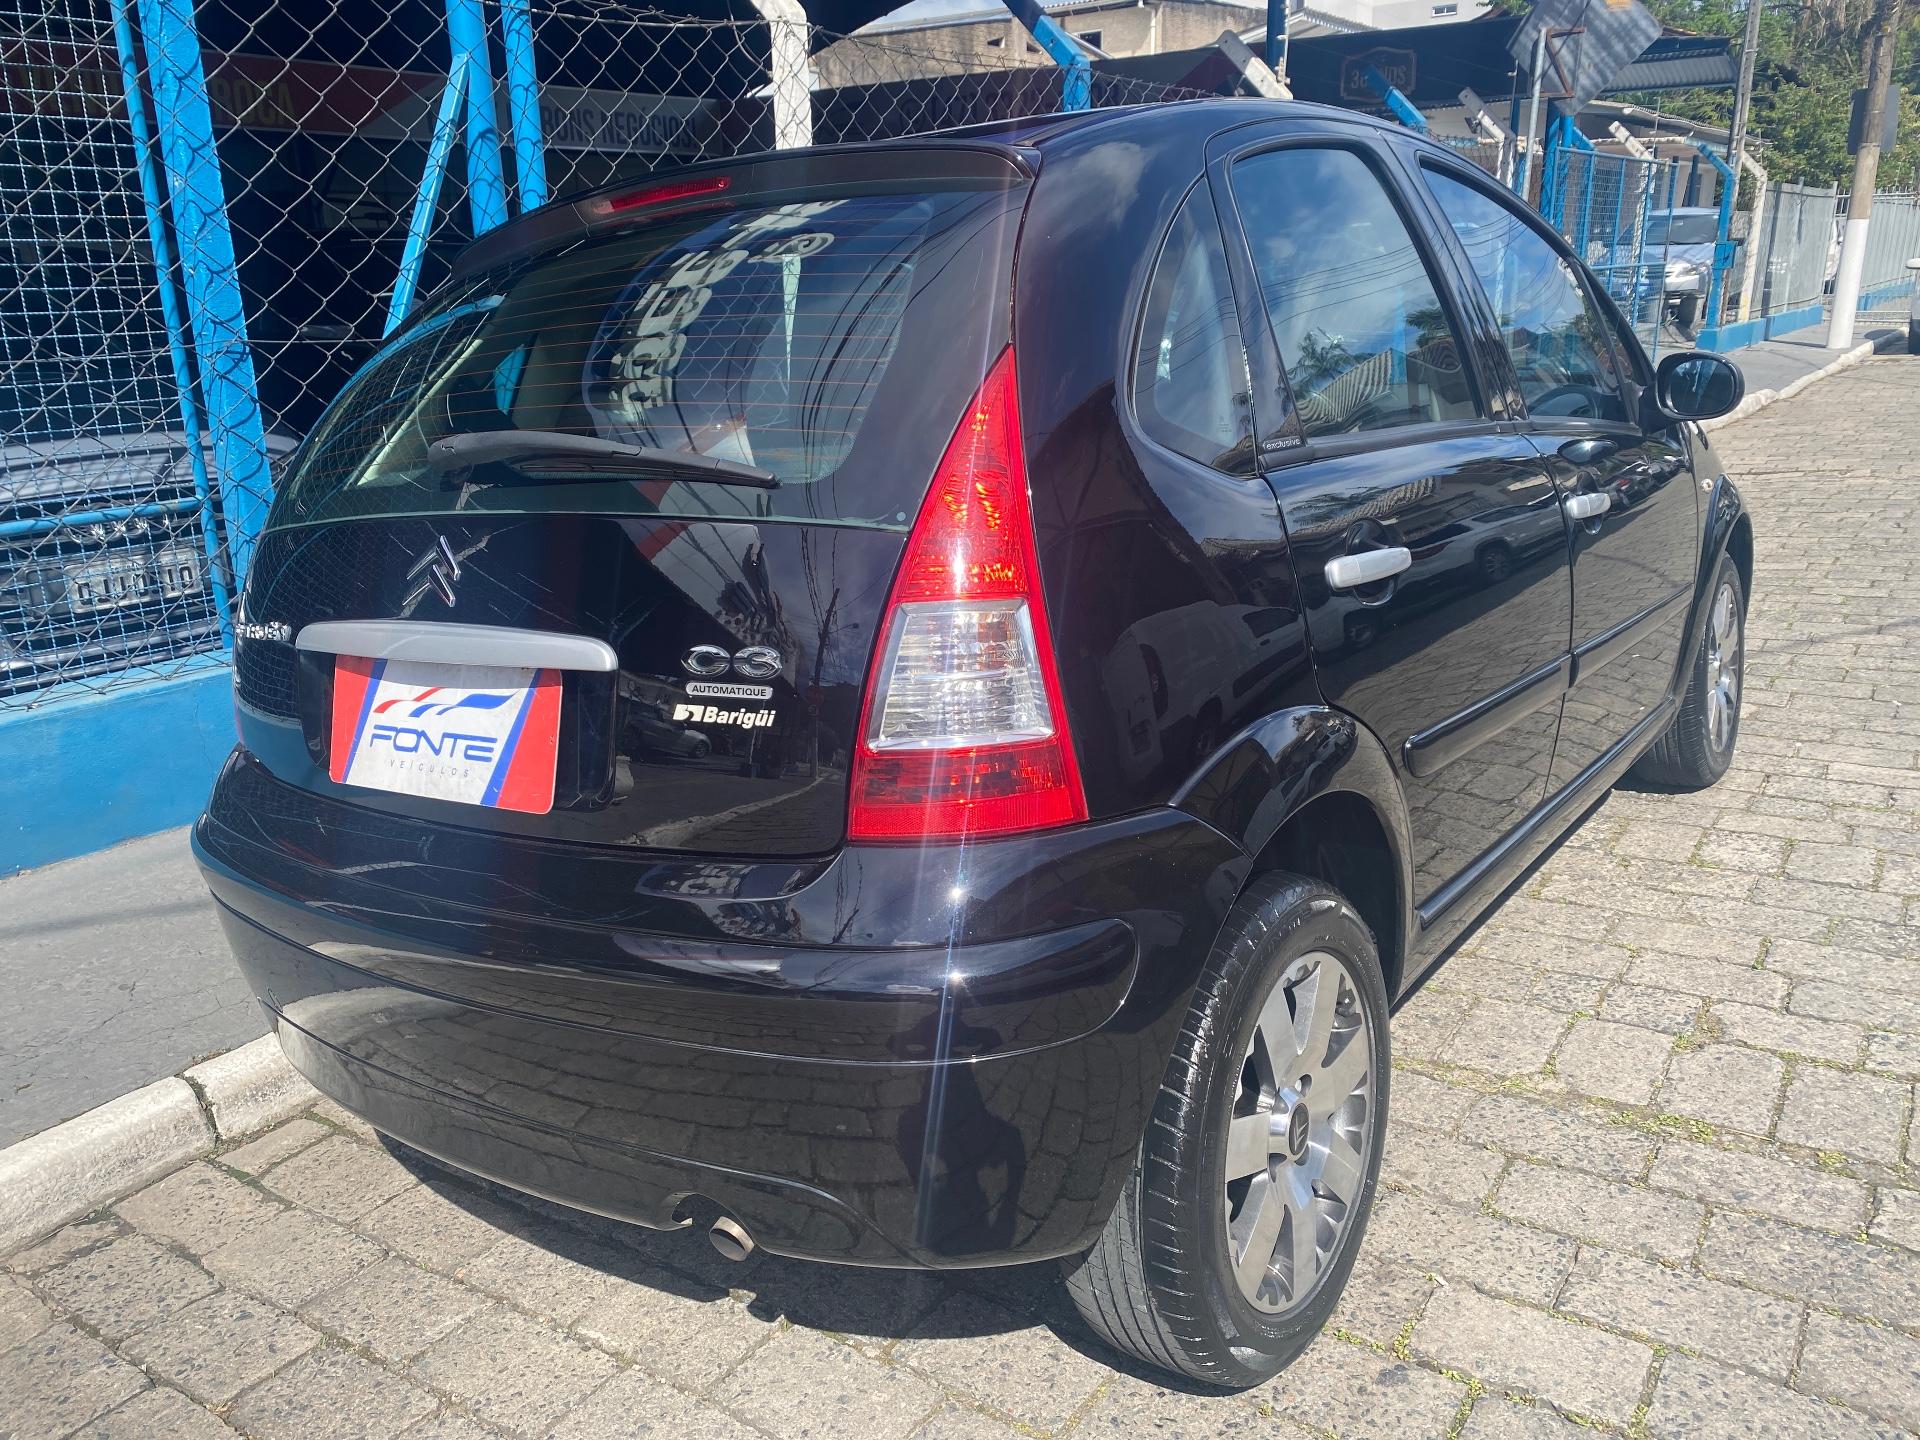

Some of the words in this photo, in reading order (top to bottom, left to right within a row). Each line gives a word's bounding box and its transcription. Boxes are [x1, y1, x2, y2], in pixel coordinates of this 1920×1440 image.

[1266, 438, 1301, 450] exclusive
[681, 644, 783, 680] C3
[691, 684, 767, 697] AUTOMATIQUE
[703, 705, 777, 730] Barigüi
[369, 724, 498, 763] FONTE
